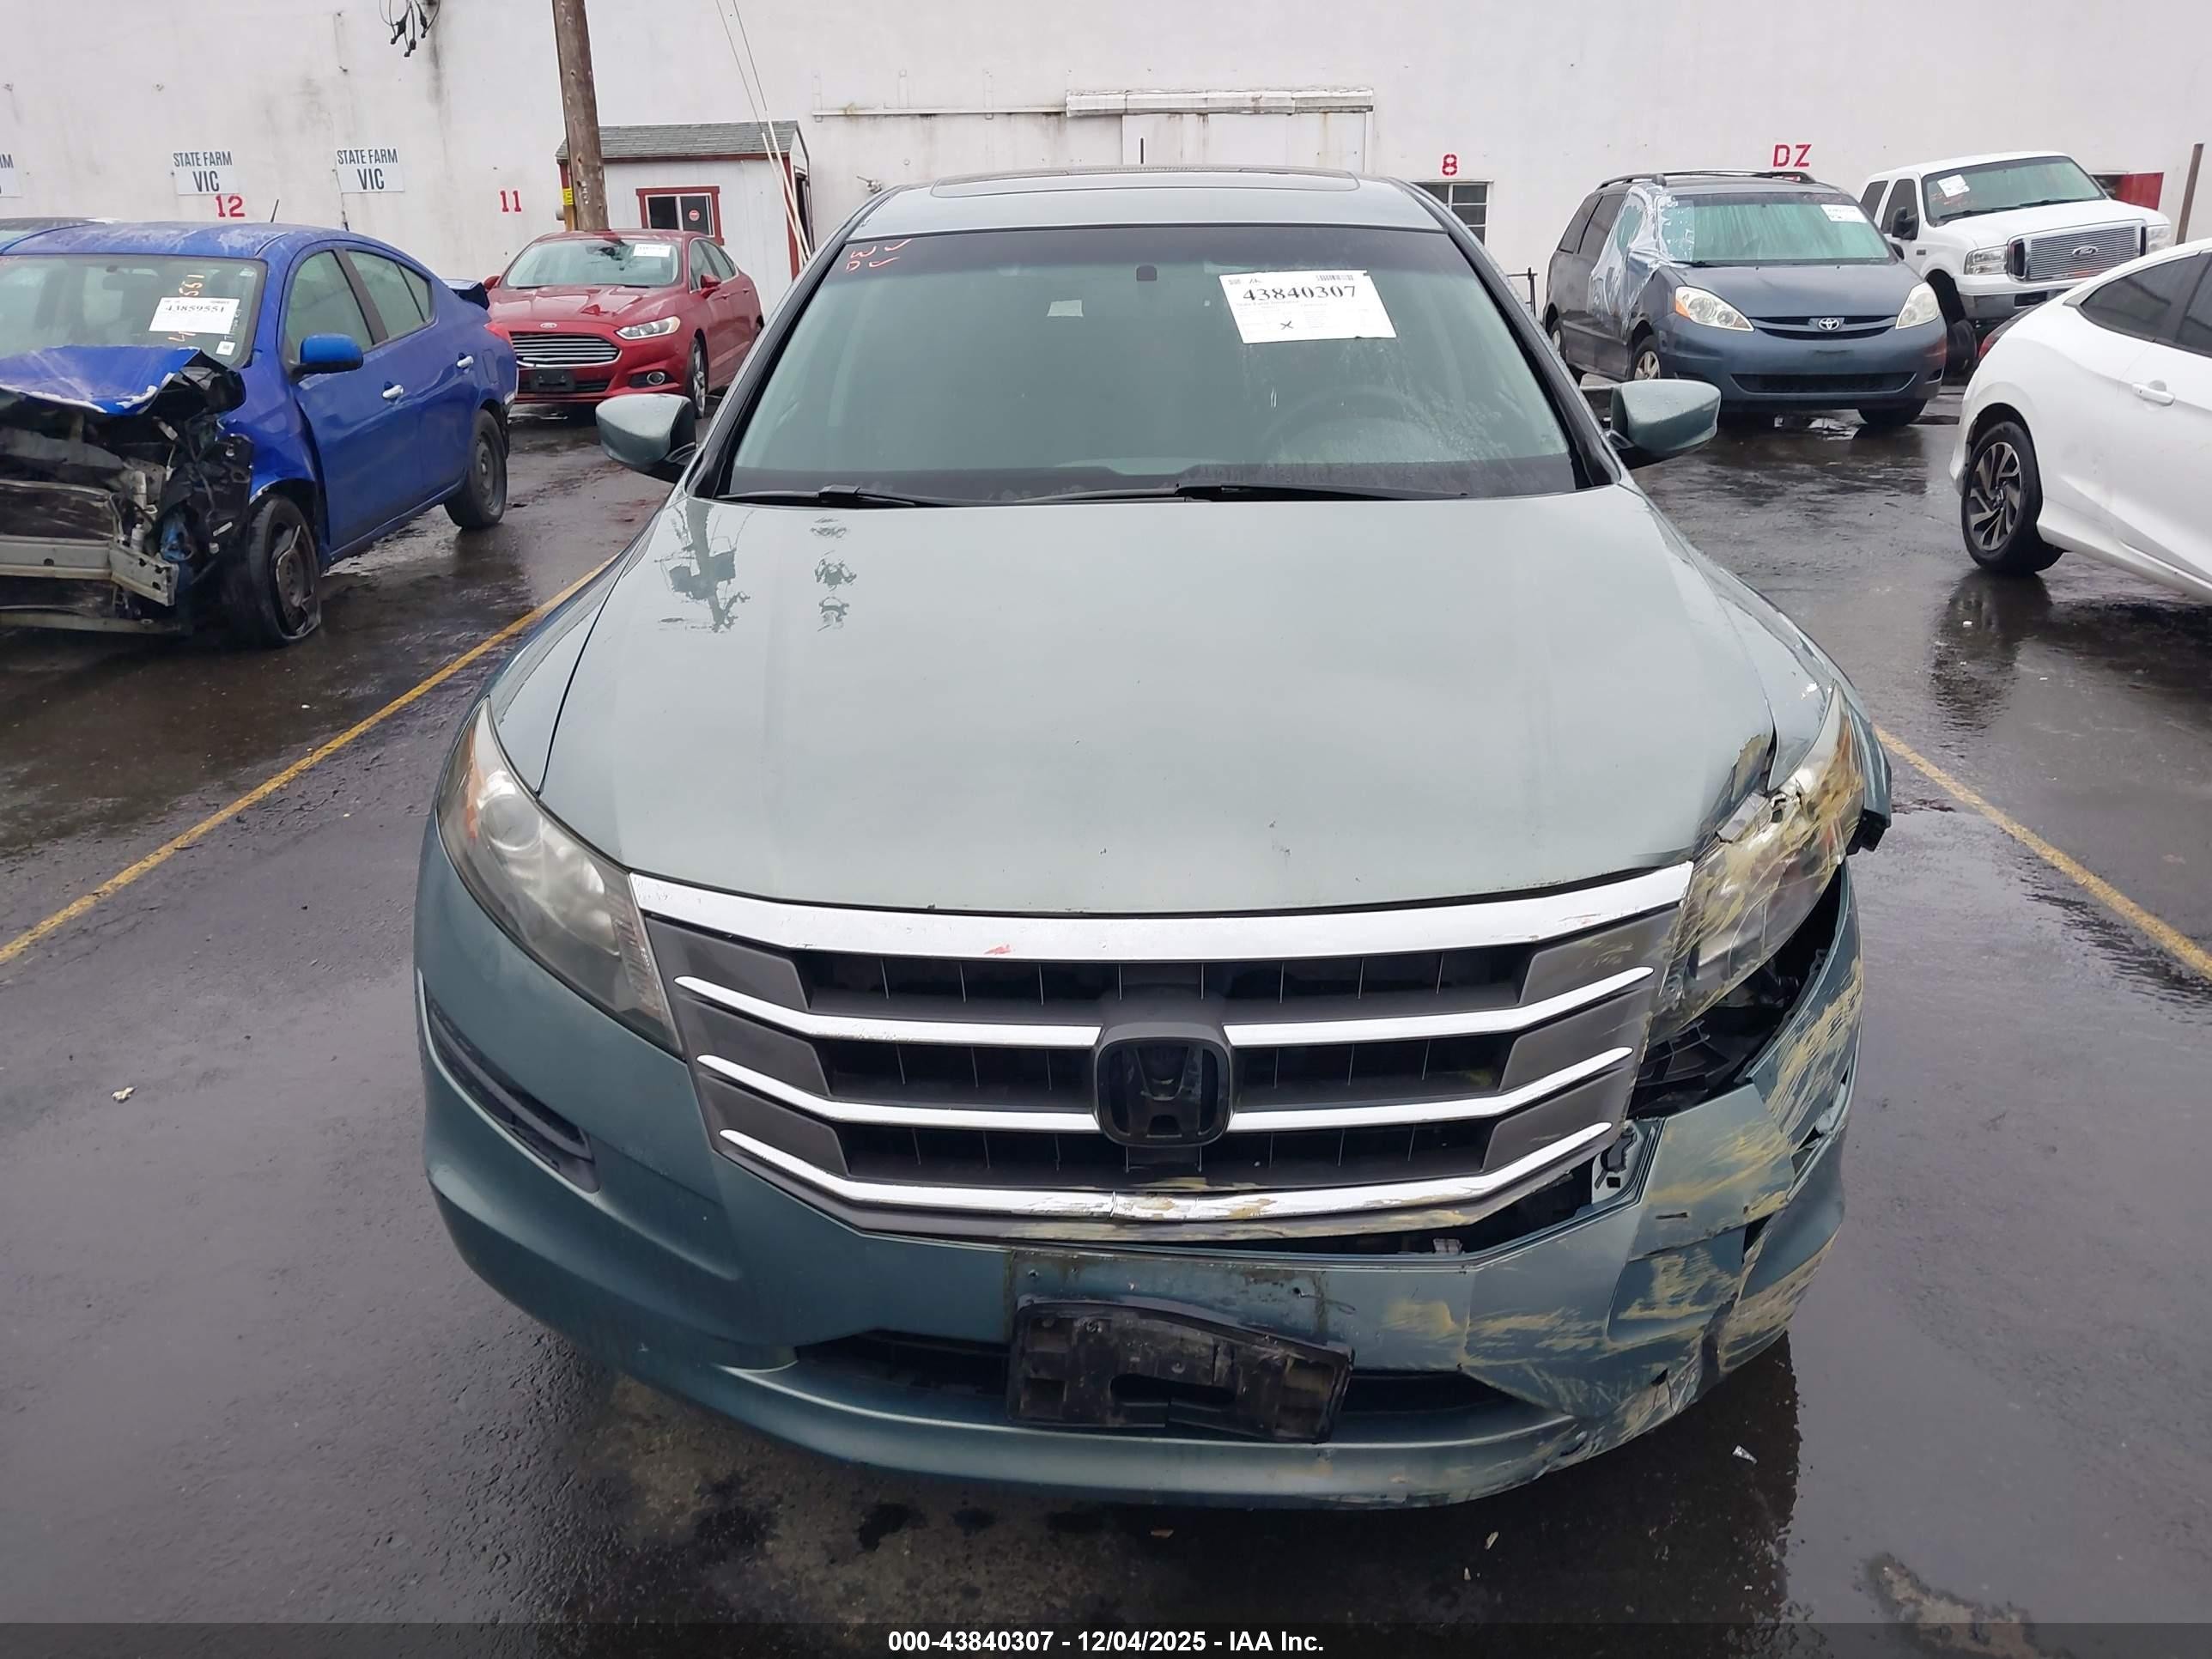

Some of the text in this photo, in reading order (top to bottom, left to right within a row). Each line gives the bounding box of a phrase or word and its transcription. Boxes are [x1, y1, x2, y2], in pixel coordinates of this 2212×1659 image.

[173, 151, 233, 167] STATE FARM
[337, 148, 398, 165] STATE FARM
[1442, 154, 1458, 176] 8
[1773, 144, 1812, 167] DZ
[192, 171, 220, 192] VIC
[357, 168, 385, 191] VIC
[216, 194, 246, 218] 12
[500, 190, 522, 213] 11
[1243, 286, 1356, 301] 43840307
